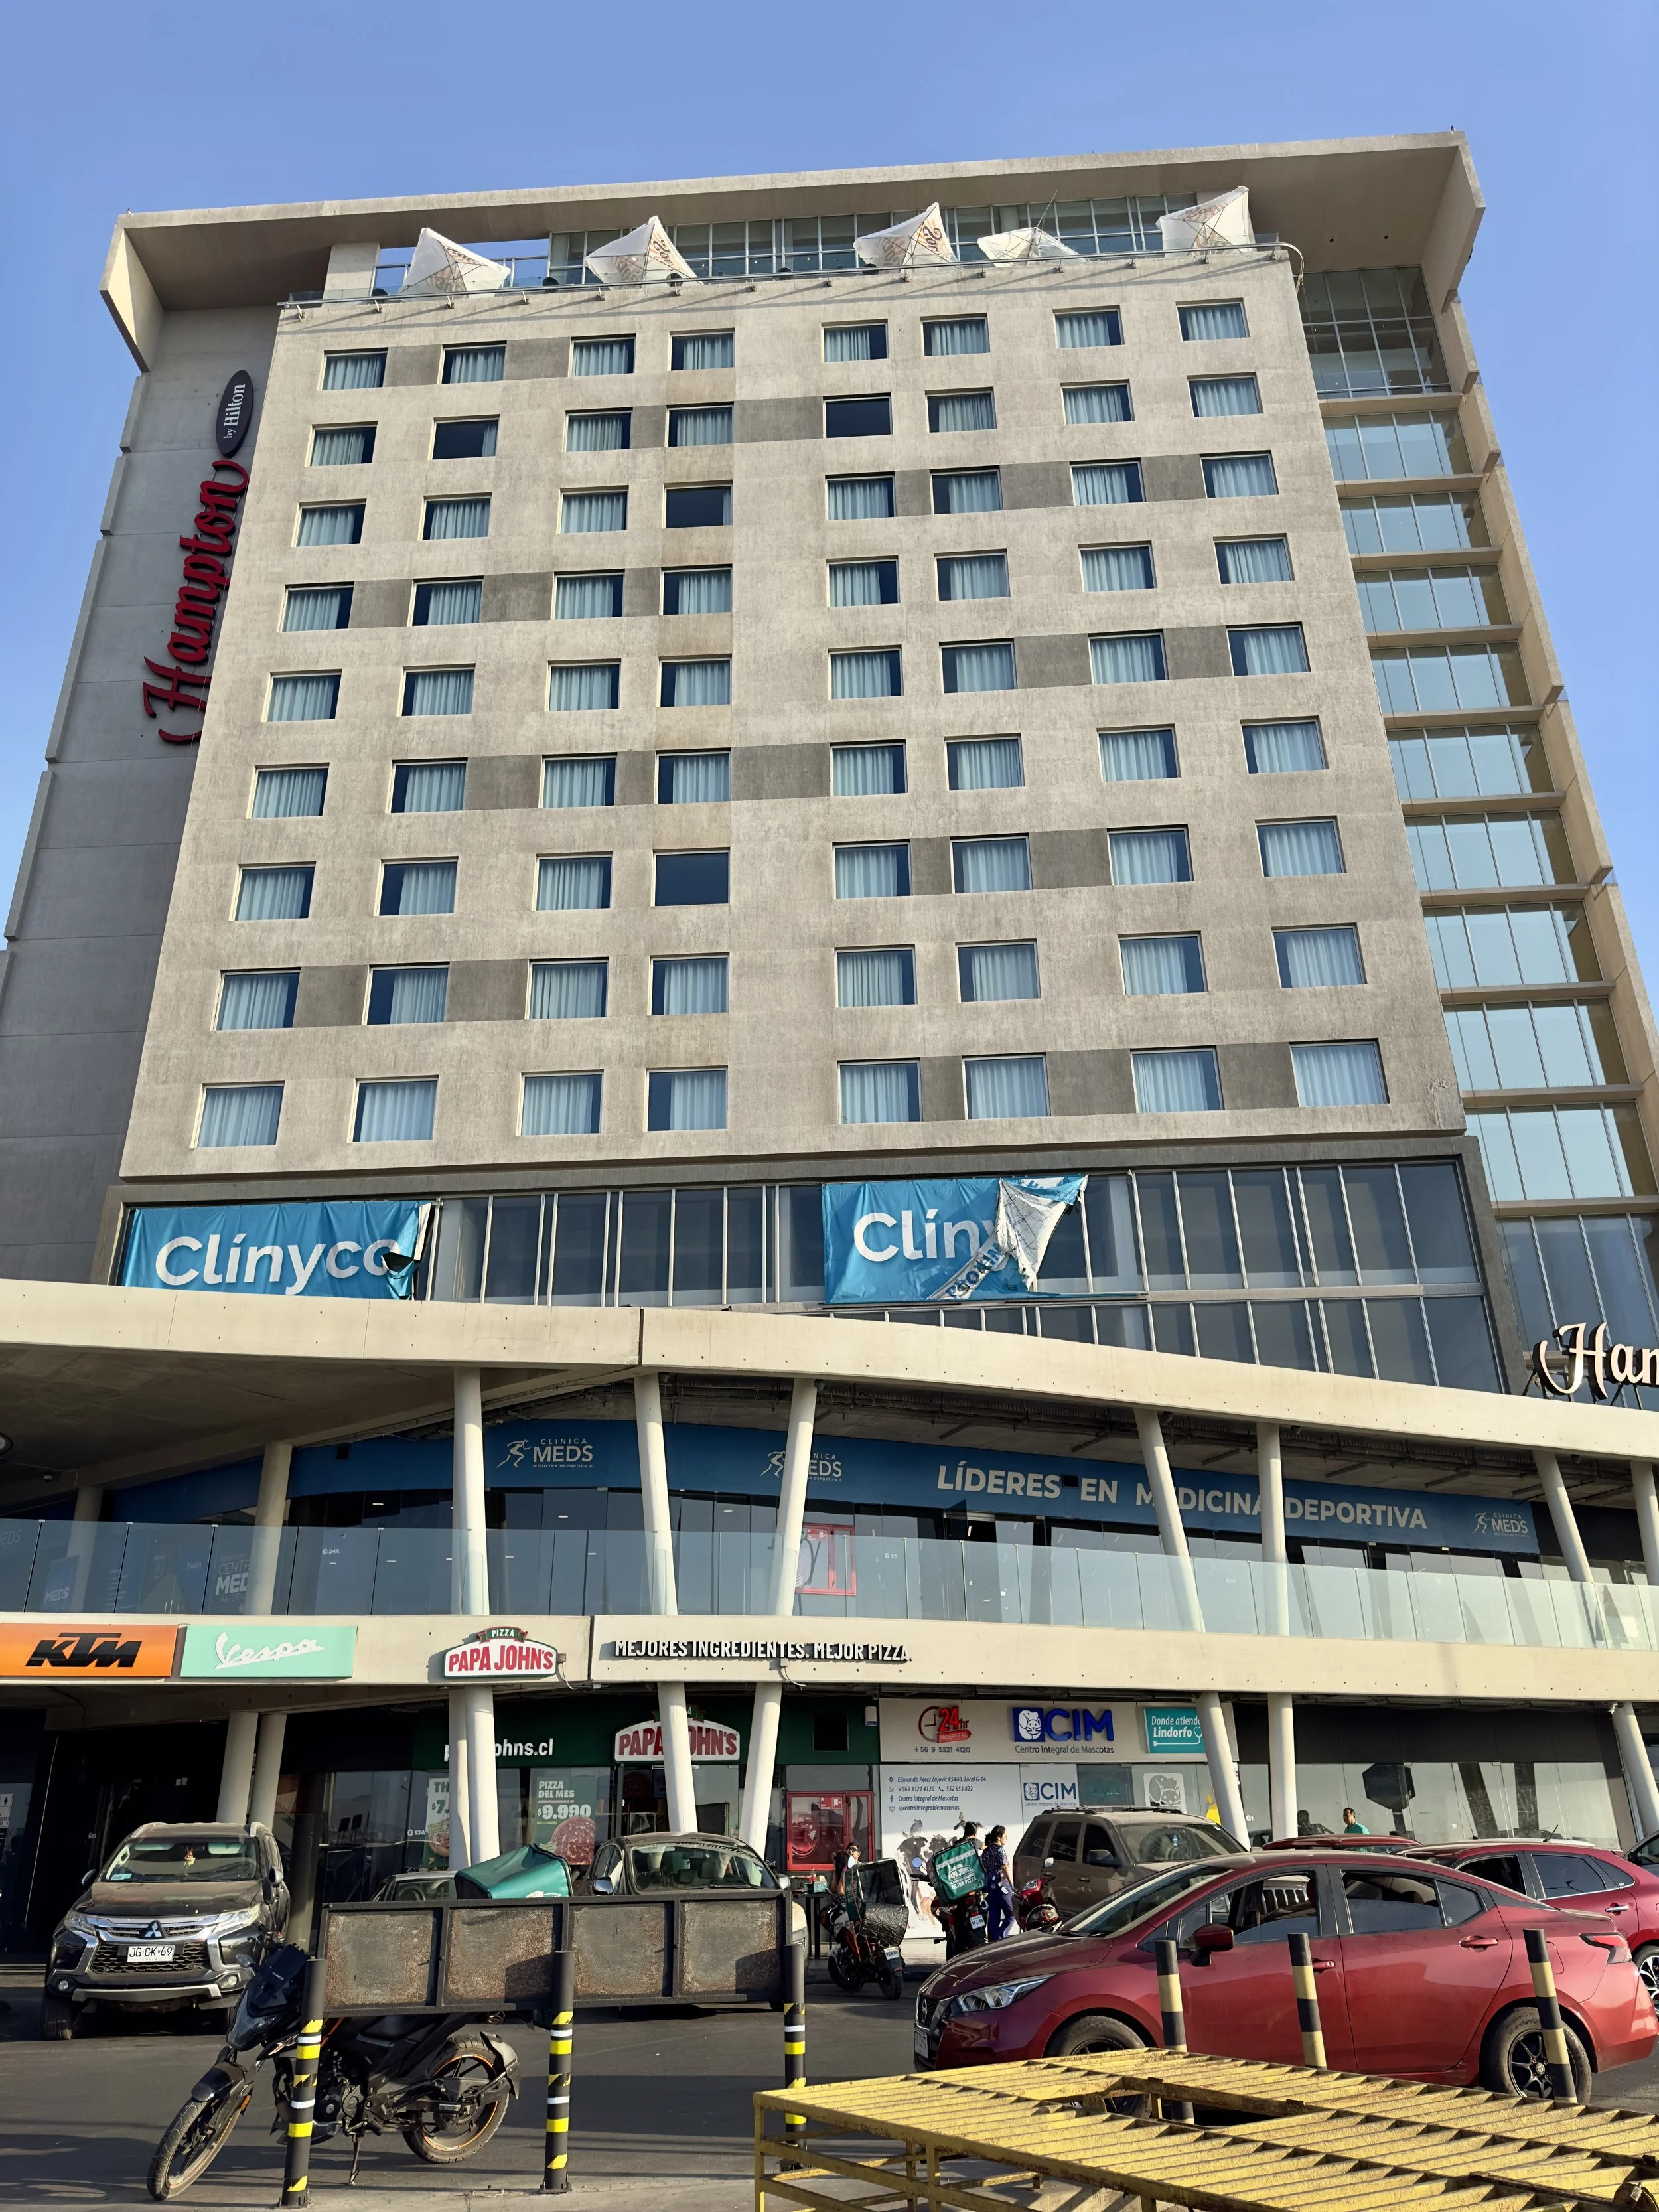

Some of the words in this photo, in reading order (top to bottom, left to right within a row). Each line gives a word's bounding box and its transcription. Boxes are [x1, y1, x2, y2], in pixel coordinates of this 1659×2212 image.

[223, 382, 246, 427] Hilton
[223, 428, 236, 440] by
[141, 459, 249, 744] Hampton
[533, 1445, 594, 1463] MEDS
[812, 1452, 837, 1461] NICA
[808, 1461, 843, 1478] EDS
[937, 1460, 1061, 1499] LÍDERES
[1080, 1477, 1118, 1503] EN
[1135, 1482, 1262, 1516] MDICINA
[1285, 1497, 1428, 1530] DEPORTIVA
[1491, 1518, 1528, 1534] MEDS
[0, 1528, 21, 1546] EDS
[491, 1629, 515, 1637] PIZZA
[25, 1632, 143, 1668] KTM
[214, 1631, 325, 1671] Vespa
[614, 1639, 688, 1657] MEJORES
[691, 1641, 810, 1659] INGREDIENTES.
[812, 1642, 865, 1660] MEJOR
[449, 1646, 491, 1672] PAPA
[494, 1645, 553, 1671] JOHN'S
[1044, 1708, 1114, 1742] CIM
[1151, 1716, 1174, 1726] Donde
[1153, 1726, 1192, 1738] Lindorfo
[618, 1726, 664, 1757] PAPA
[689, 1727, 737, 1756] OHN'S
[1015, 1745, 1040, 1754] Centro
[1041, 1745, 1069, 1755] Integral
[1070, 1745, 1080, 1753] de
[1081, 1745, 1114, 1754] Mascotas
[538, 1781, 564, 1789] PIZZA
[1040, 1782, 1077, 1801] CIM
[538, 1790, 554, 1799] DEL
[555, 1790, 575, 1799] MES
[537, 1804, 591, 1820] $9.990
[964, 1876, 977, 1885] PIZZA
[272, 1971, 284, 1981] HONDA
